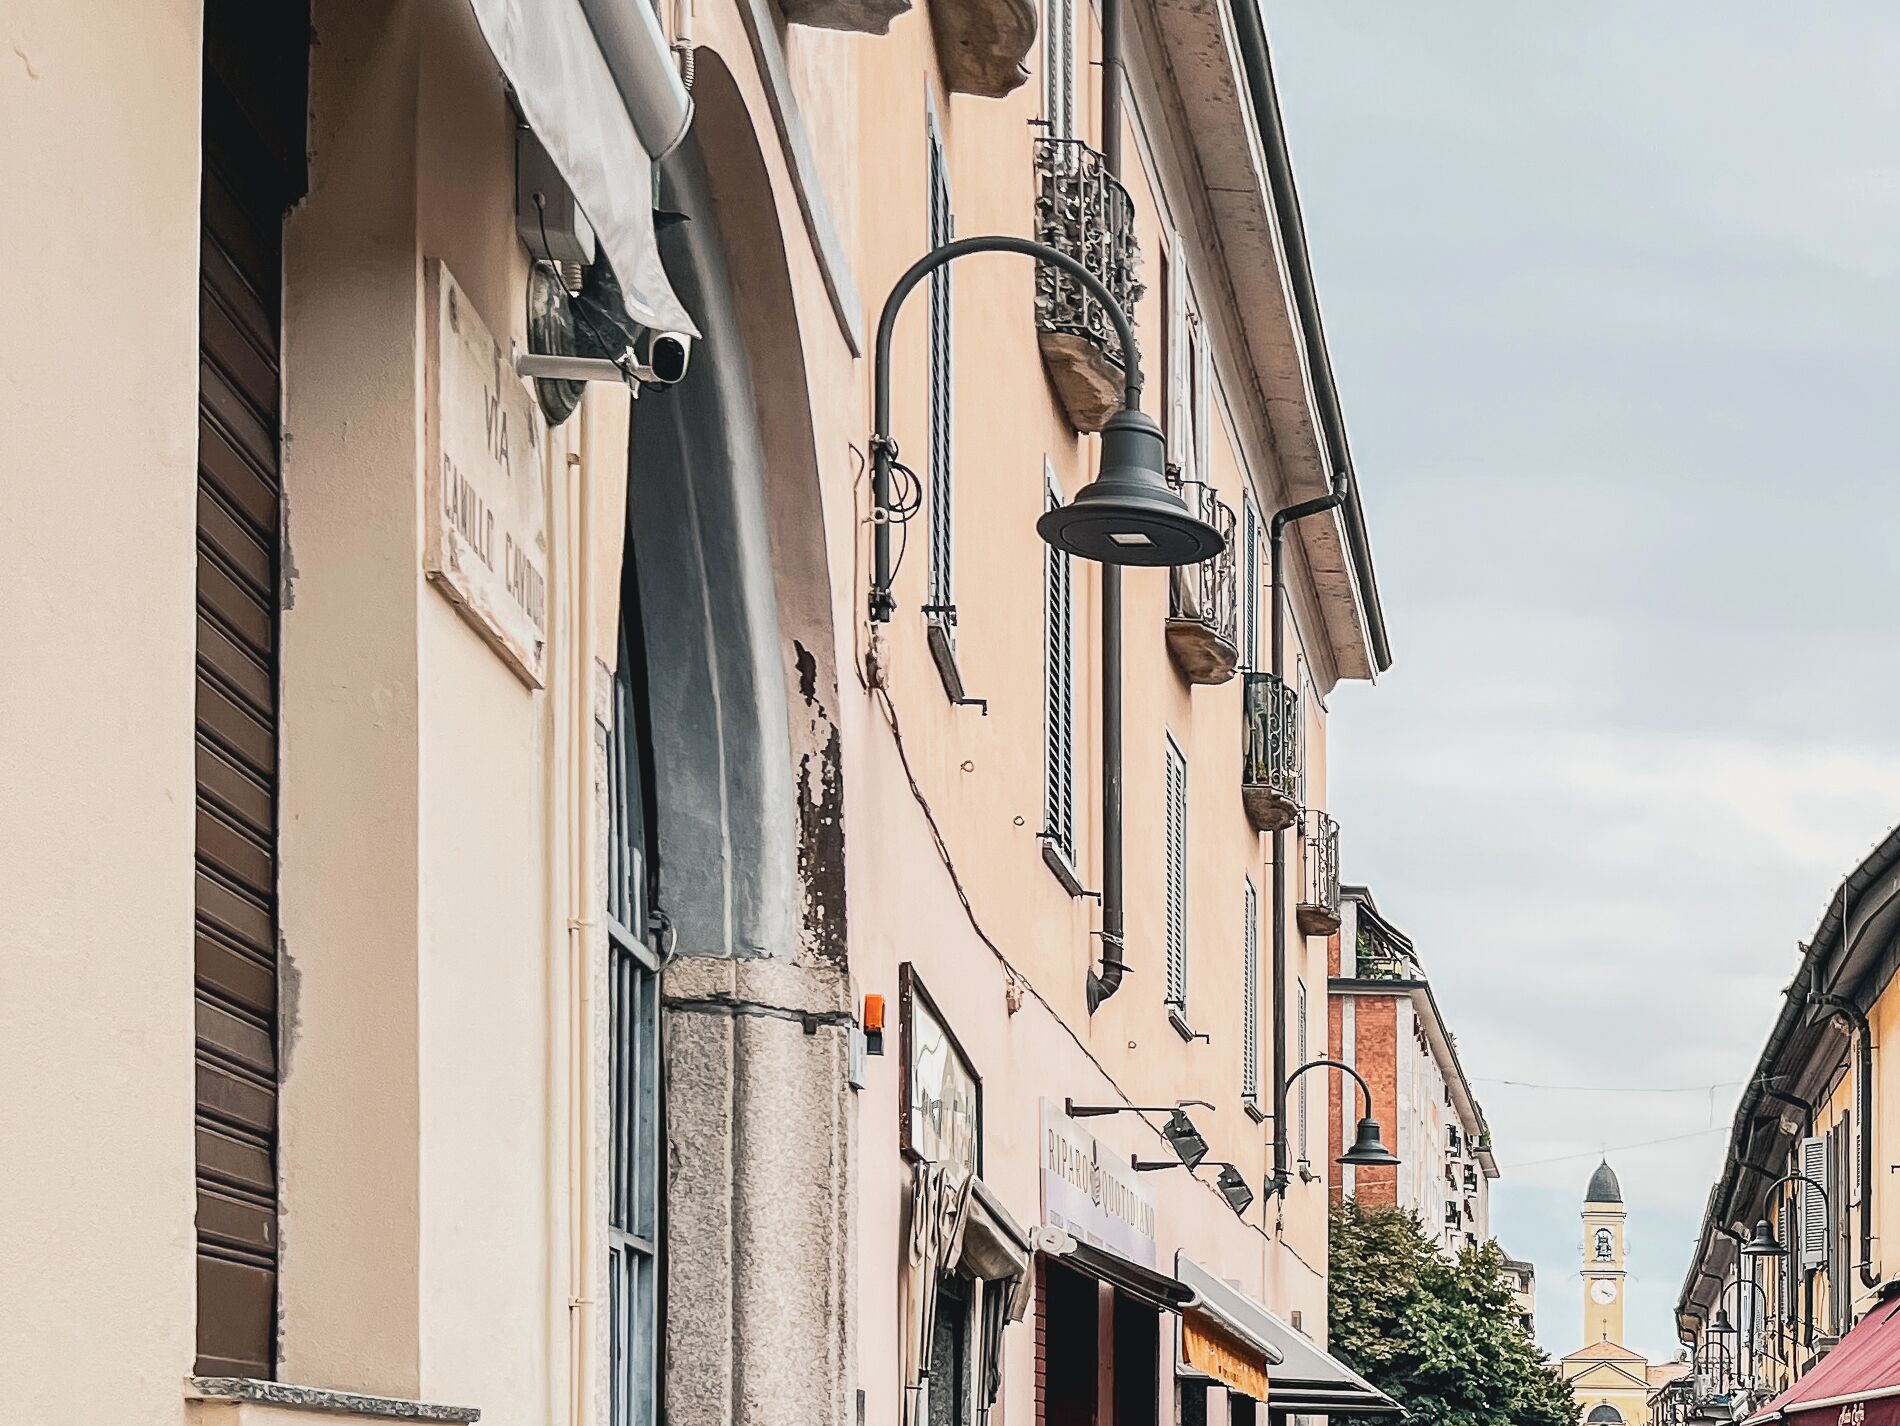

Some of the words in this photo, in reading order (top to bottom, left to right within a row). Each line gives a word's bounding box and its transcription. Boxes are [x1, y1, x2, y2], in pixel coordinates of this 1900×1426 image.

[484, 384, 510, 477] VIA
[443, 451, 494, 573] CAMILLO
[505, 531, 544, 635] CAVOUR
[1049, 1128, 1088, 1194] RIPARO
[1102, 1170, 1155, 1241] QUOTIDIANO
